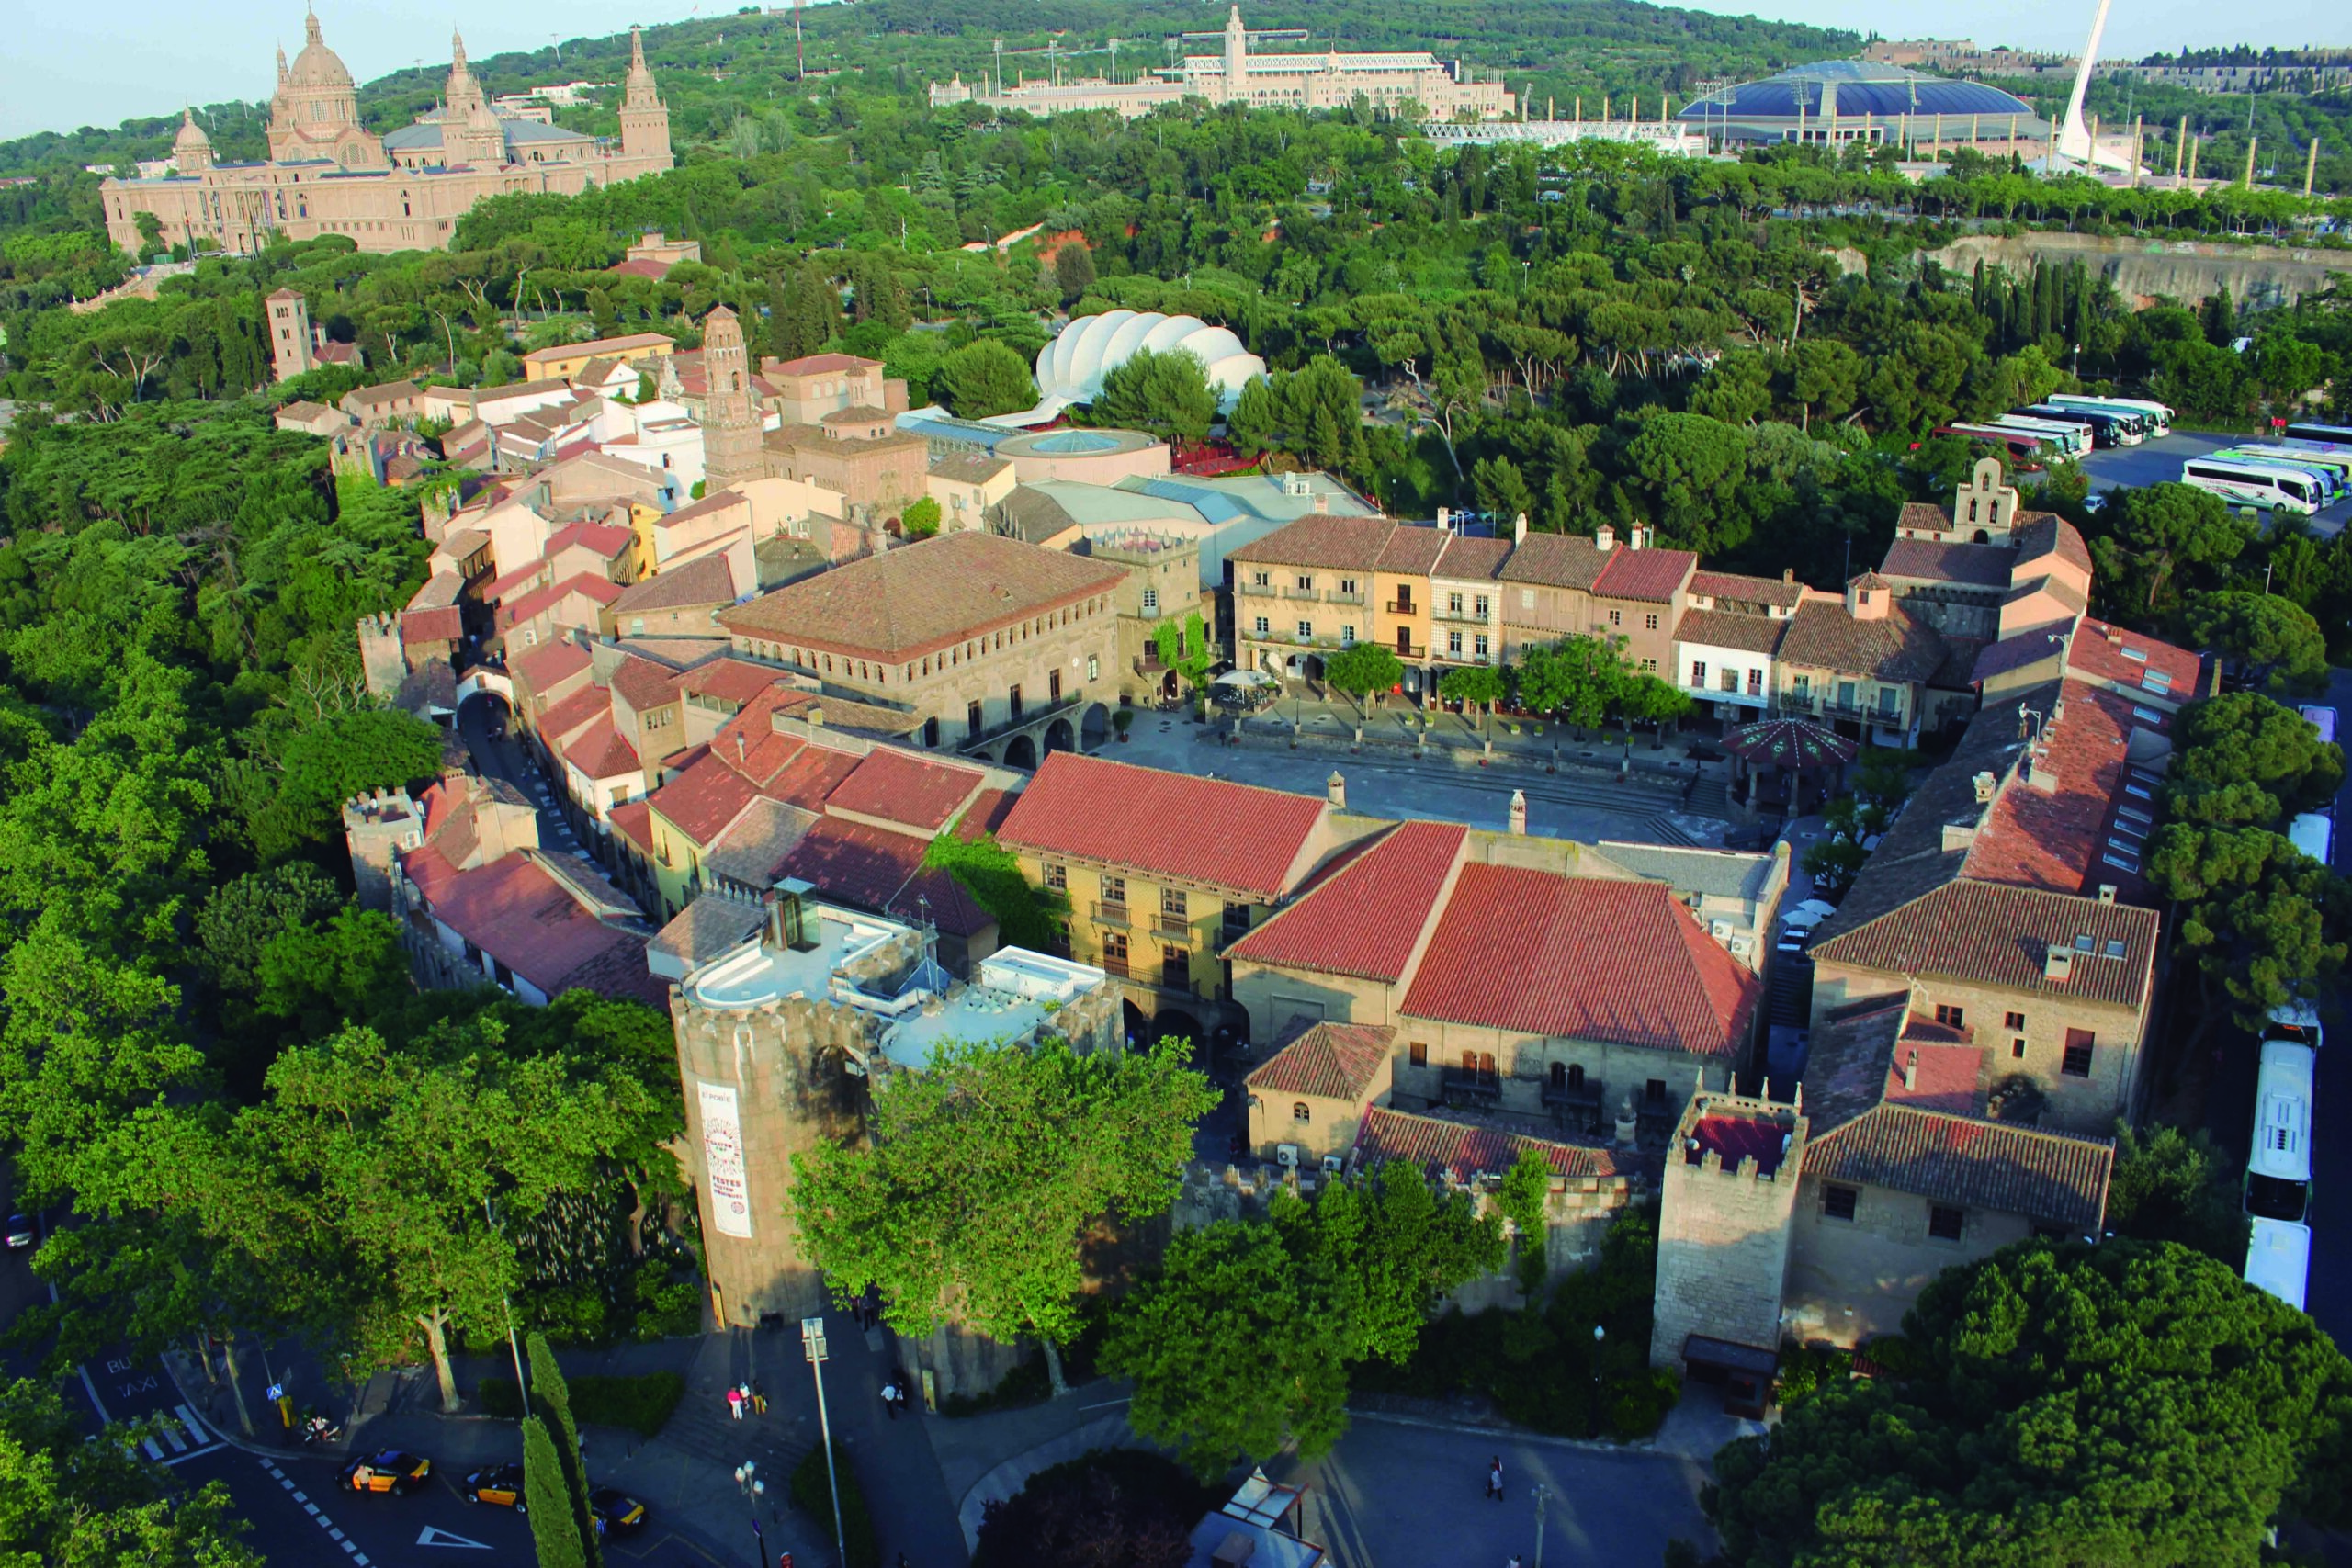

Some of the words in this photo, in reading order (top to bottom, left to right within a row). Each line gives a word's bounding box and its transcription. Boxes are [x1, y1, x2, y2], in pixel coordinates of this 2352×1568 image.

[712, 1176, 741, 1187] FESTES
[107, 1356, 132, 1373] BU
[117, 1376, 158, 1398] TAXI
